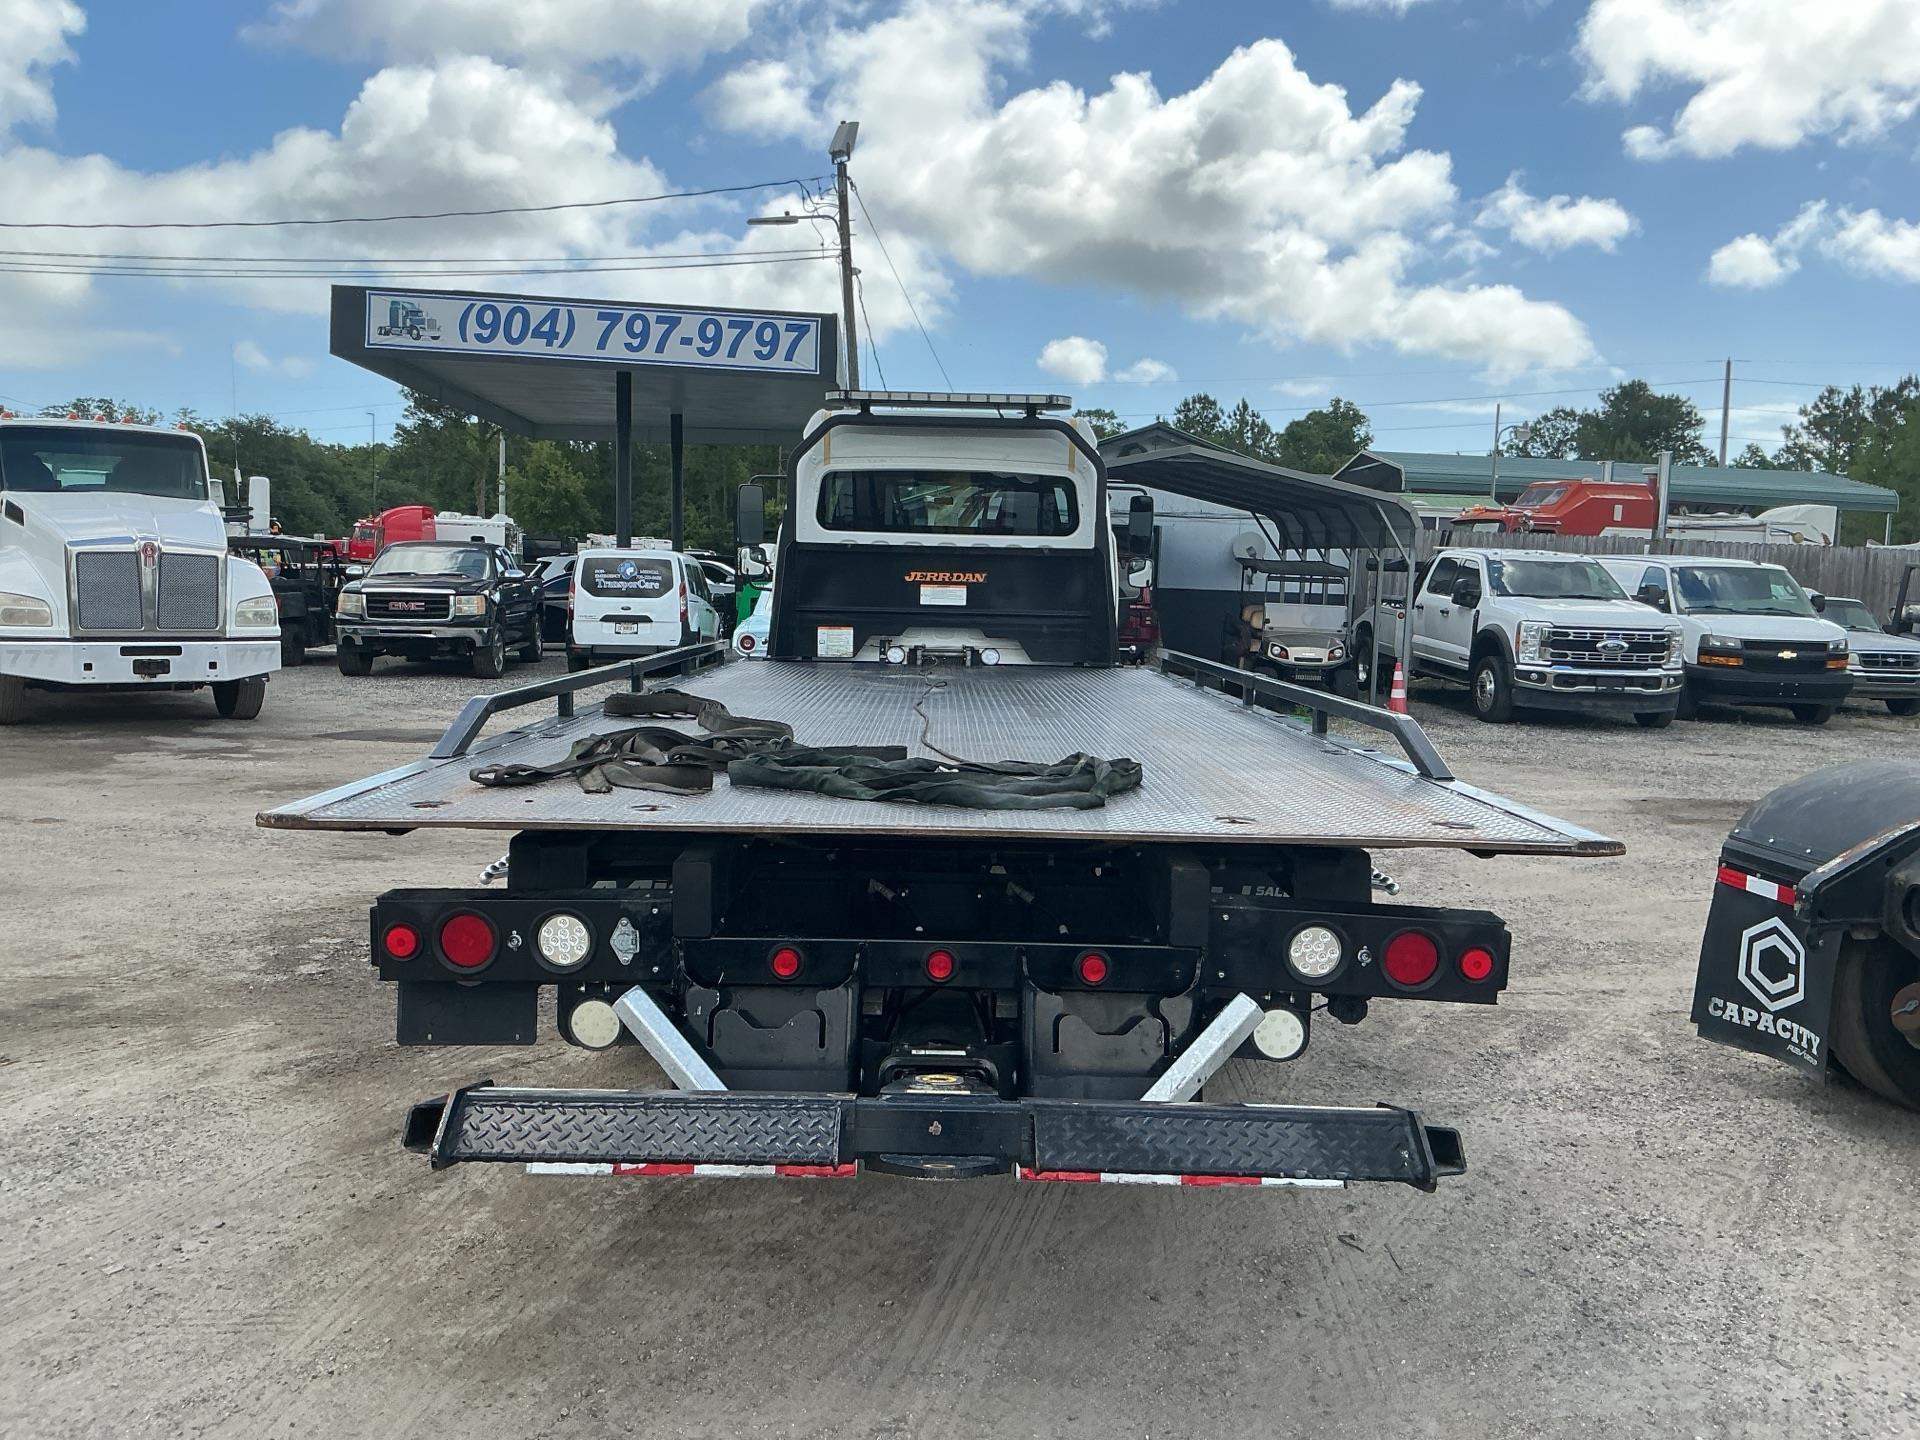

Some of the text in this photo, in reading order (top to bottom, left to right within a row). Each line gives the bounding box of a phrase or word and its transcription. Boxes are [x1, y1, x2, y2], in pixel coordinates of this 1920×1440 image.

[458, 303, 811, 362] (904) 797-9797
[388, 601, 425, 611] GMC
[1708, 997, 1820, 1056] CAPACITY
